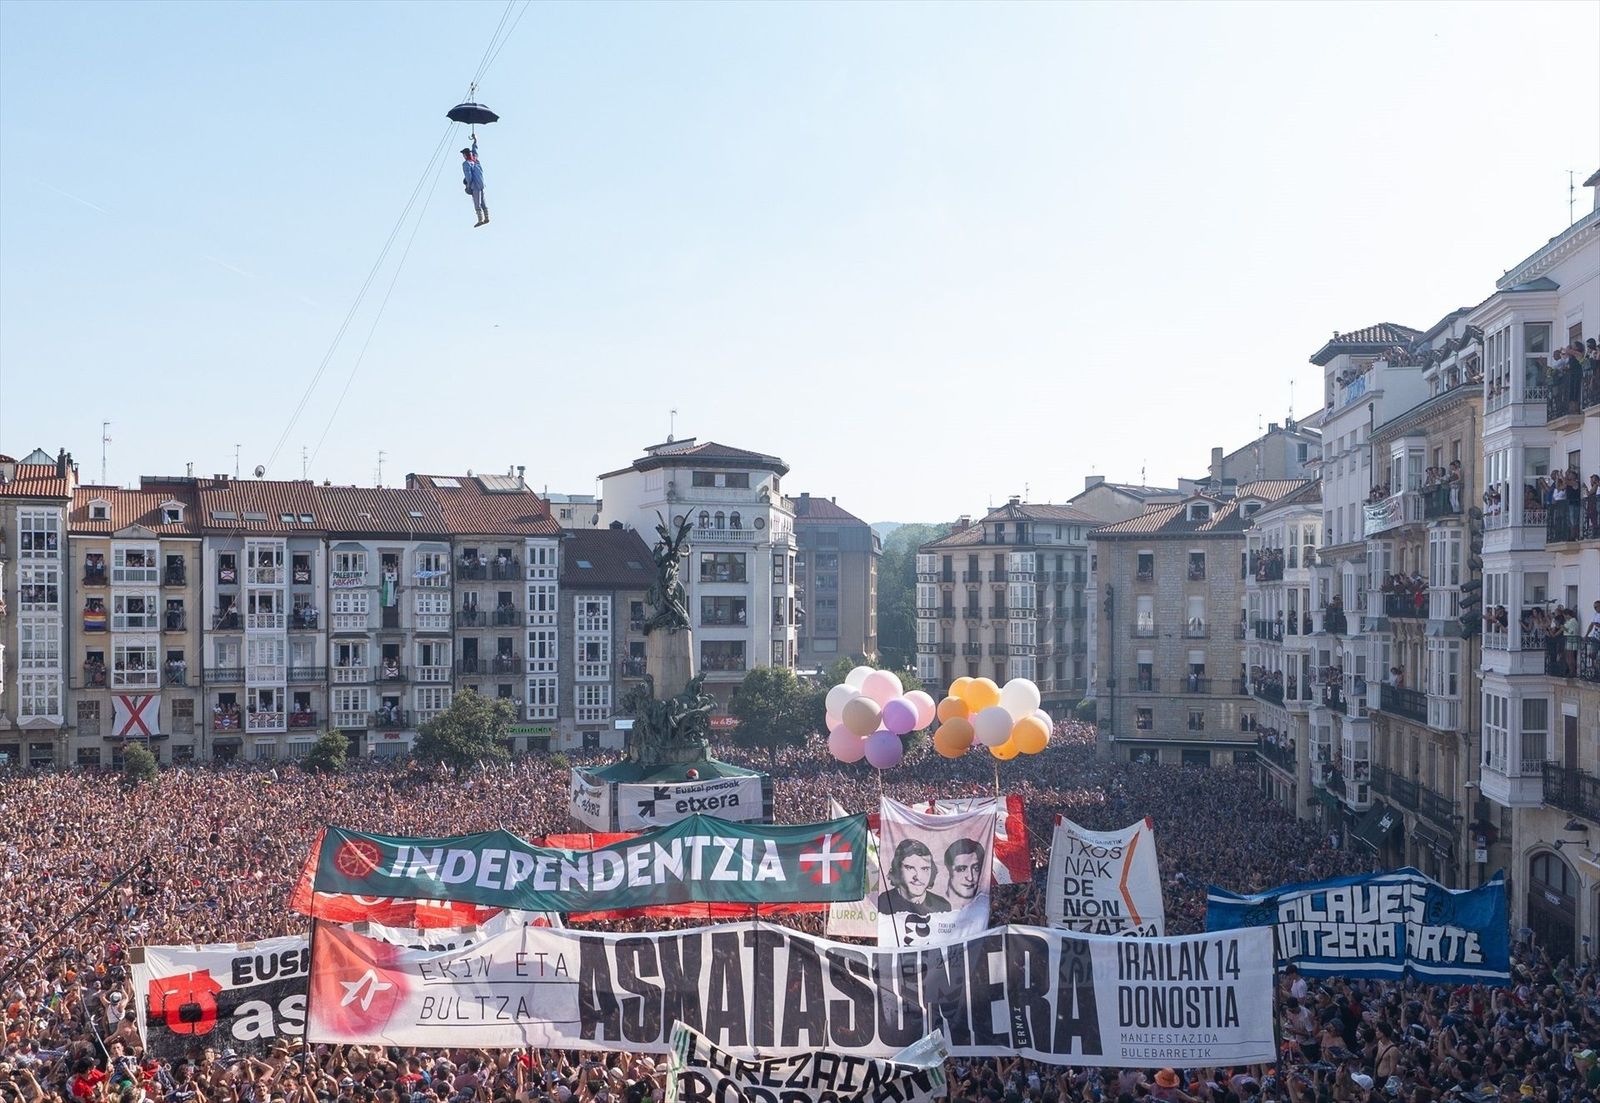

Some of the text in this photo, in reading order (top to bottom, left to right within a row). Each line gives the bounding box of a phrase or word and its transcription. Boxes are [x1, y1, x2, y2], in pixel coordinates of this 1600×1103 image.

[675, 779, 740, 795] Euskal presoak
[675, 792, 740, 814] etxera
[1066, 836, 1123, 859] TXOS
[389, 835, 787, 892] INDEPENDENTZIA
[1064, 856, 1112, 879] NAK
[1063, 877, 1094, 897] DE
[831, 909, 864, 921] LURRA
[1063, 898, 1120, 917] NON
[1406, 920, 1483, 963] ARTE
[419, 952, 569, 981] EKIN ETA
[1117, 940, 1209, 981] IRAILAK
[1214, 939, 1241, 981] 14
[579, 929, 1104, 1056] ASKATASUNERA
[420, 995, 531, 1020] BULTZA
[1118, 985, 1240, 1028] DONOSTIA
[1017, 1006, 1027, 1046] ERNAI
[1120, 1033, 1219, 1043] MANIFESTAZIOA
[1121, 1047, 1212, 1058] BULEBARRETIK
